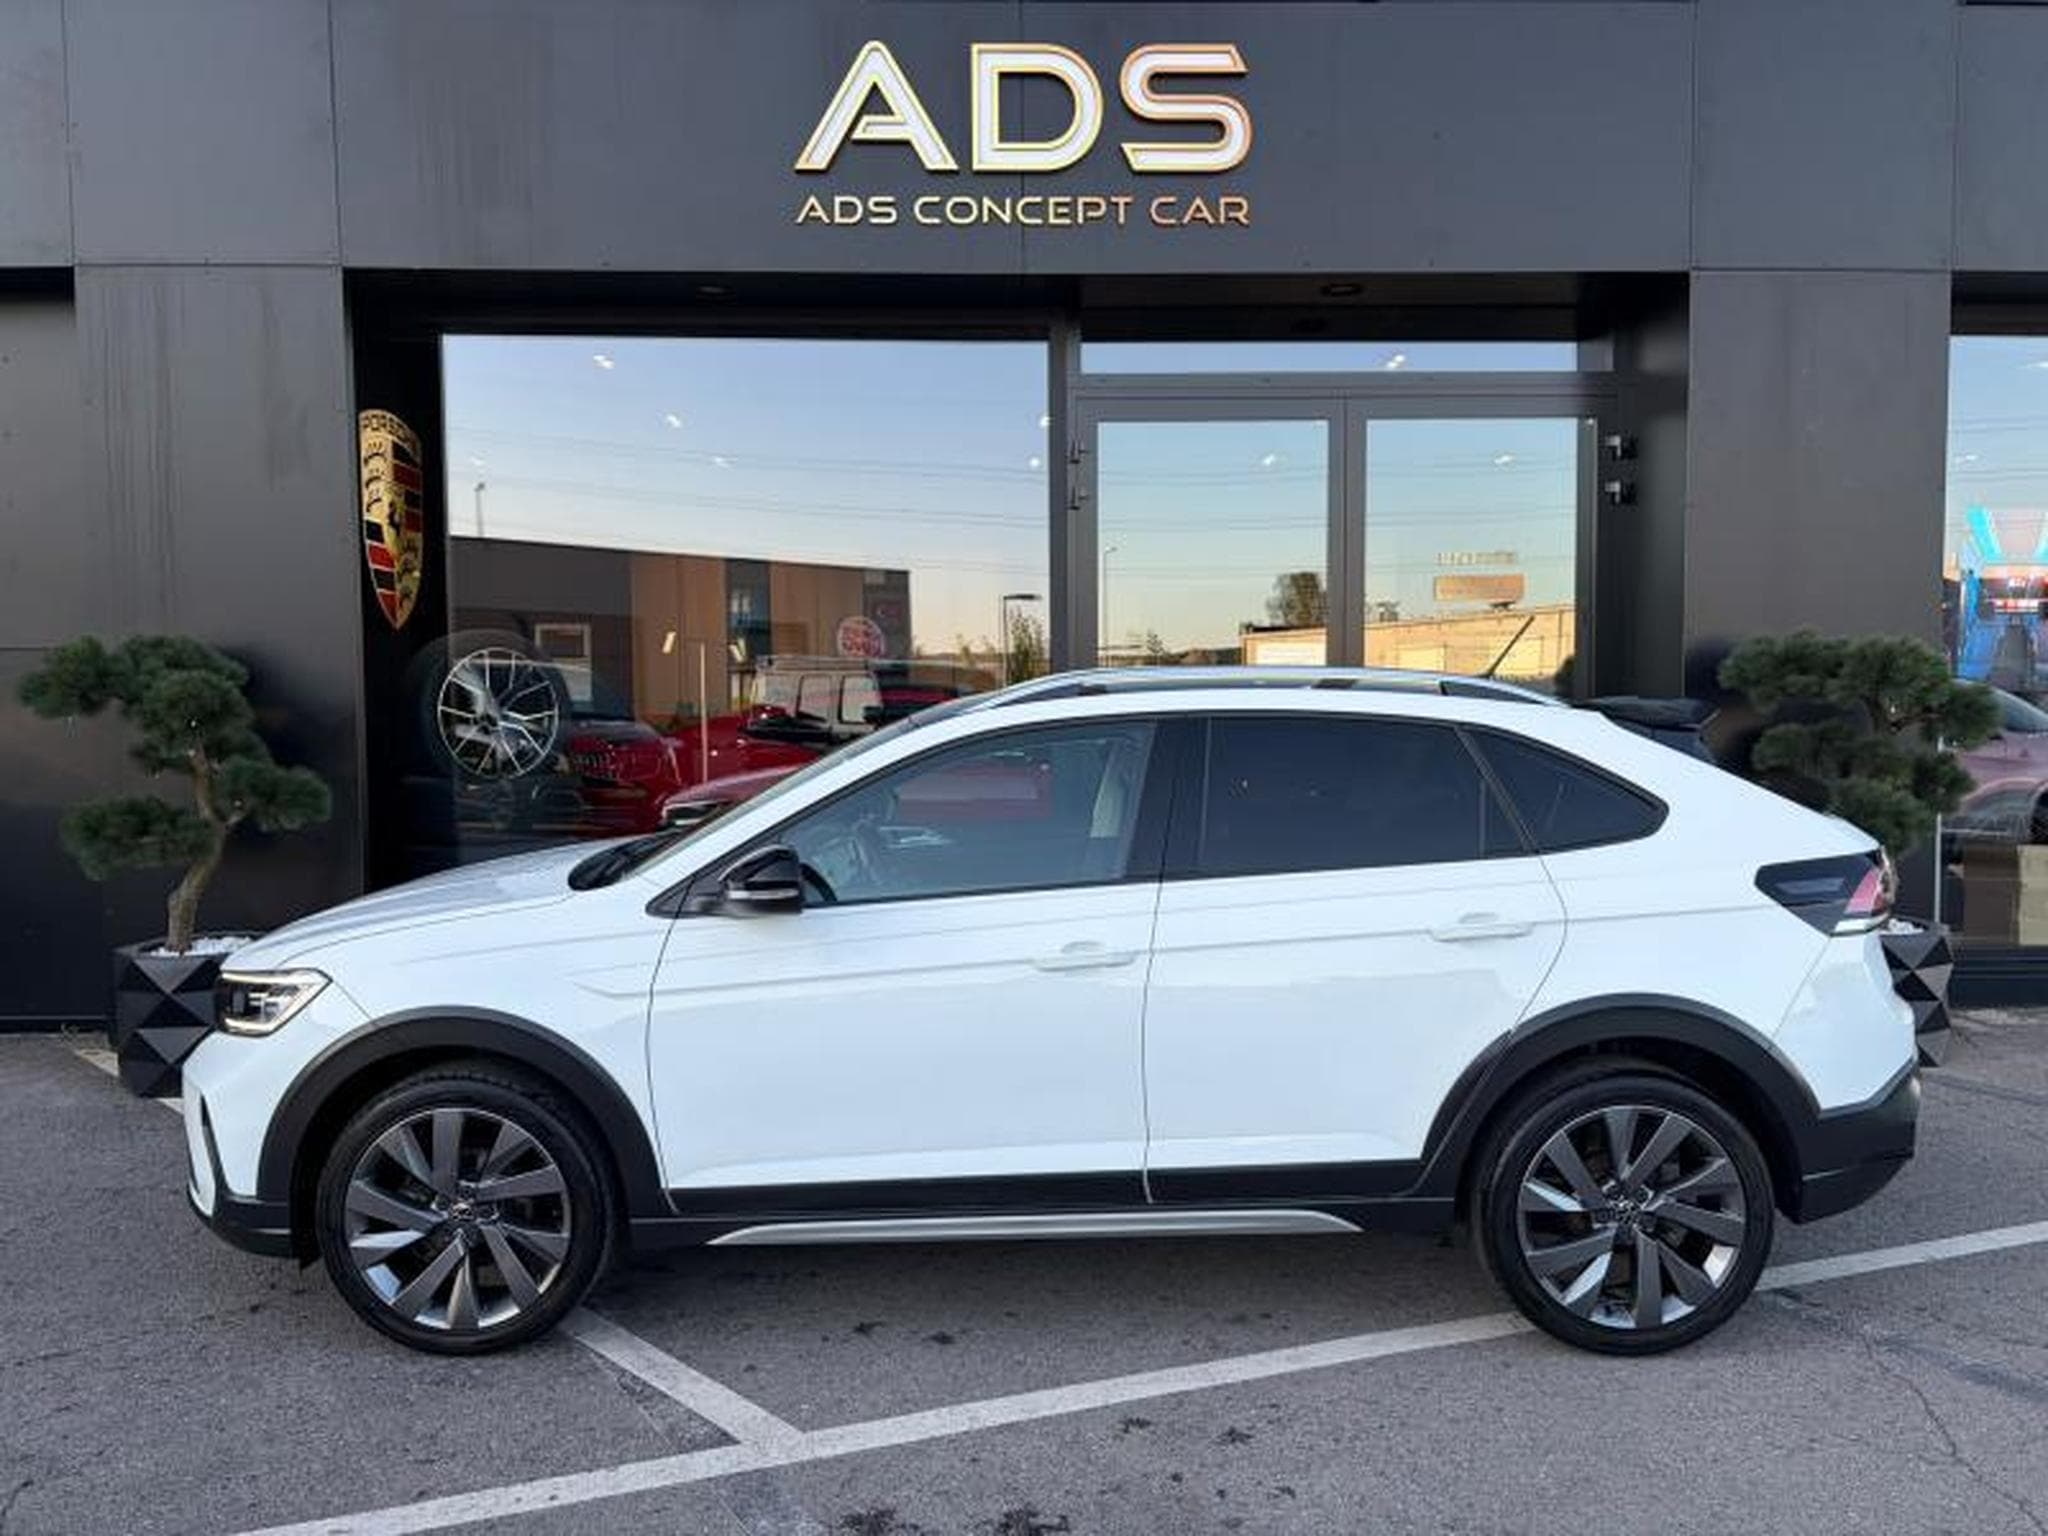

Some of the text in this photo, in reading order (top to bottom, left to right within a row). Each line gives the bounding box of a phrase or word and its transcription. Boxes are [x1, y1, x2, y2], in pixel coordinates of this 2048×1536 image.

[795, 40, 1254, 172] ADS
[796, 196, 1251, 225] ADS CONCEPT CAR
